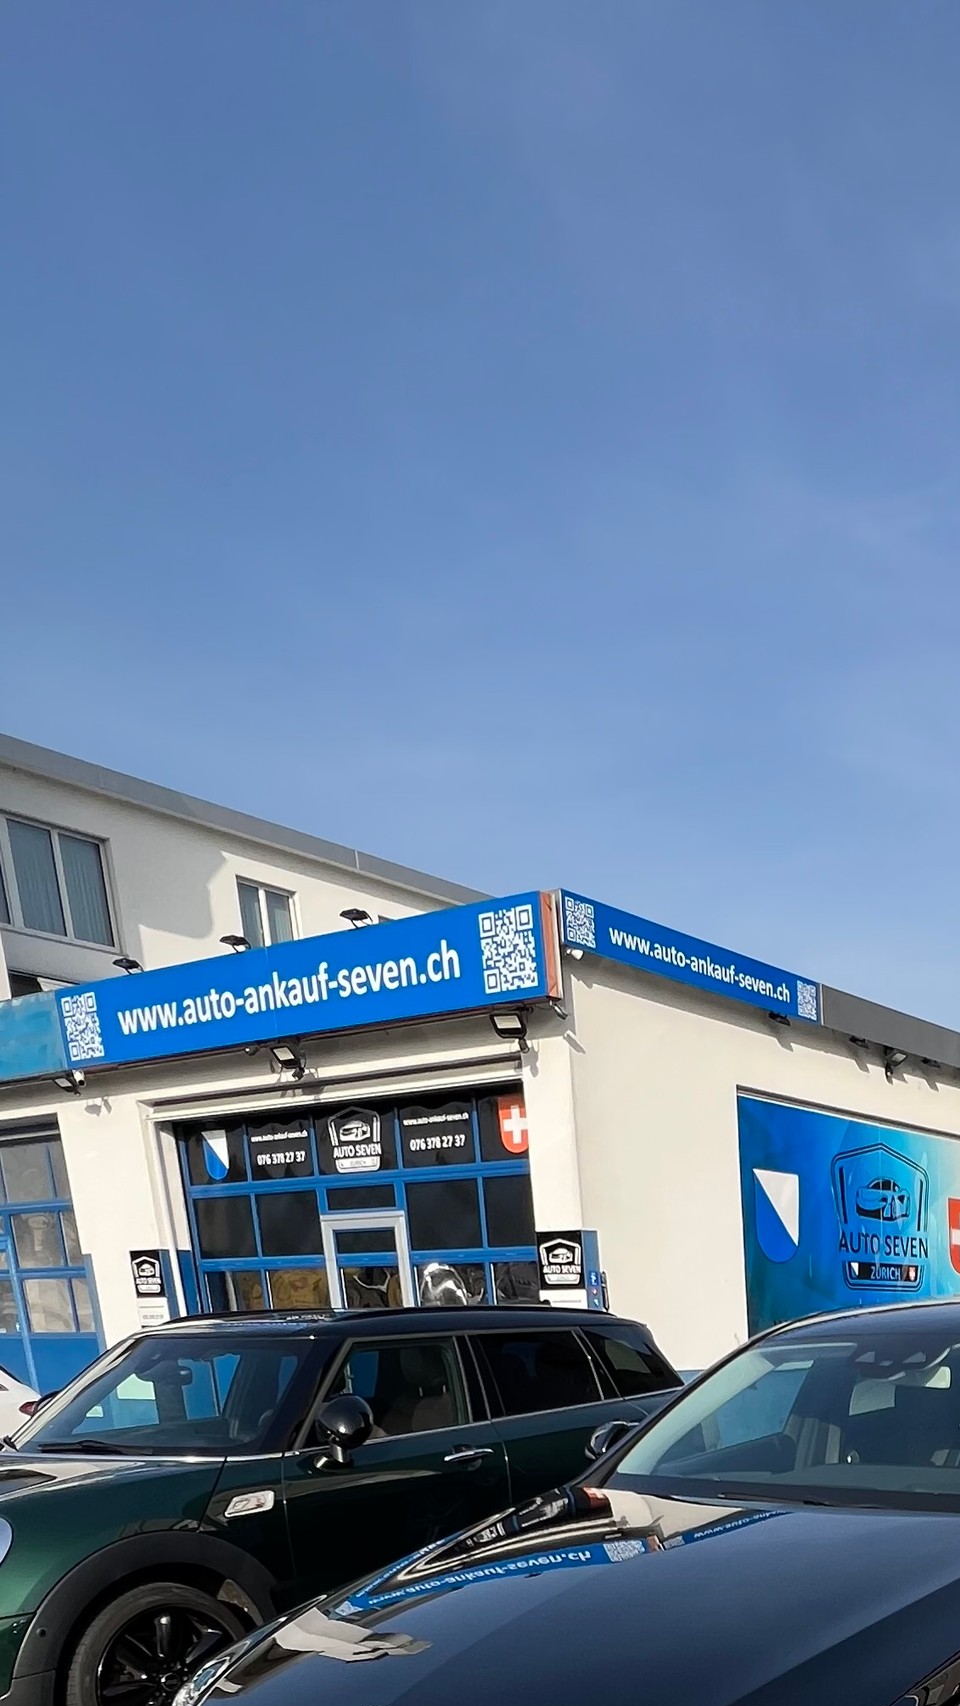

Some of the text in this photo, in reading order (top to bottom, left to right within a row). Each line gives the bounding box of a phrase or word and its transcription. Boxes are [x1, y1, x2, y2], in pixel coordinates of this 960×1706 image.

[609, 926, 791, 1003] www.auto-ankauf-seven.ch
[117, 938, 461, 1036] www.auto-ankauf-seven.ch
[333, 1143, 382, 1159] AUTO SEVEN
[410, 1134, 466, 1152] 076 378 27 37
[257, 1151, 306, 1166] 076 378 27 37
[839, 1231, 929, 1258] AUTO SEVEN
[543, 1264, 581, 1274] AUTO SEVEN
[870, 1265, 900, 1280] ZÜRICH
